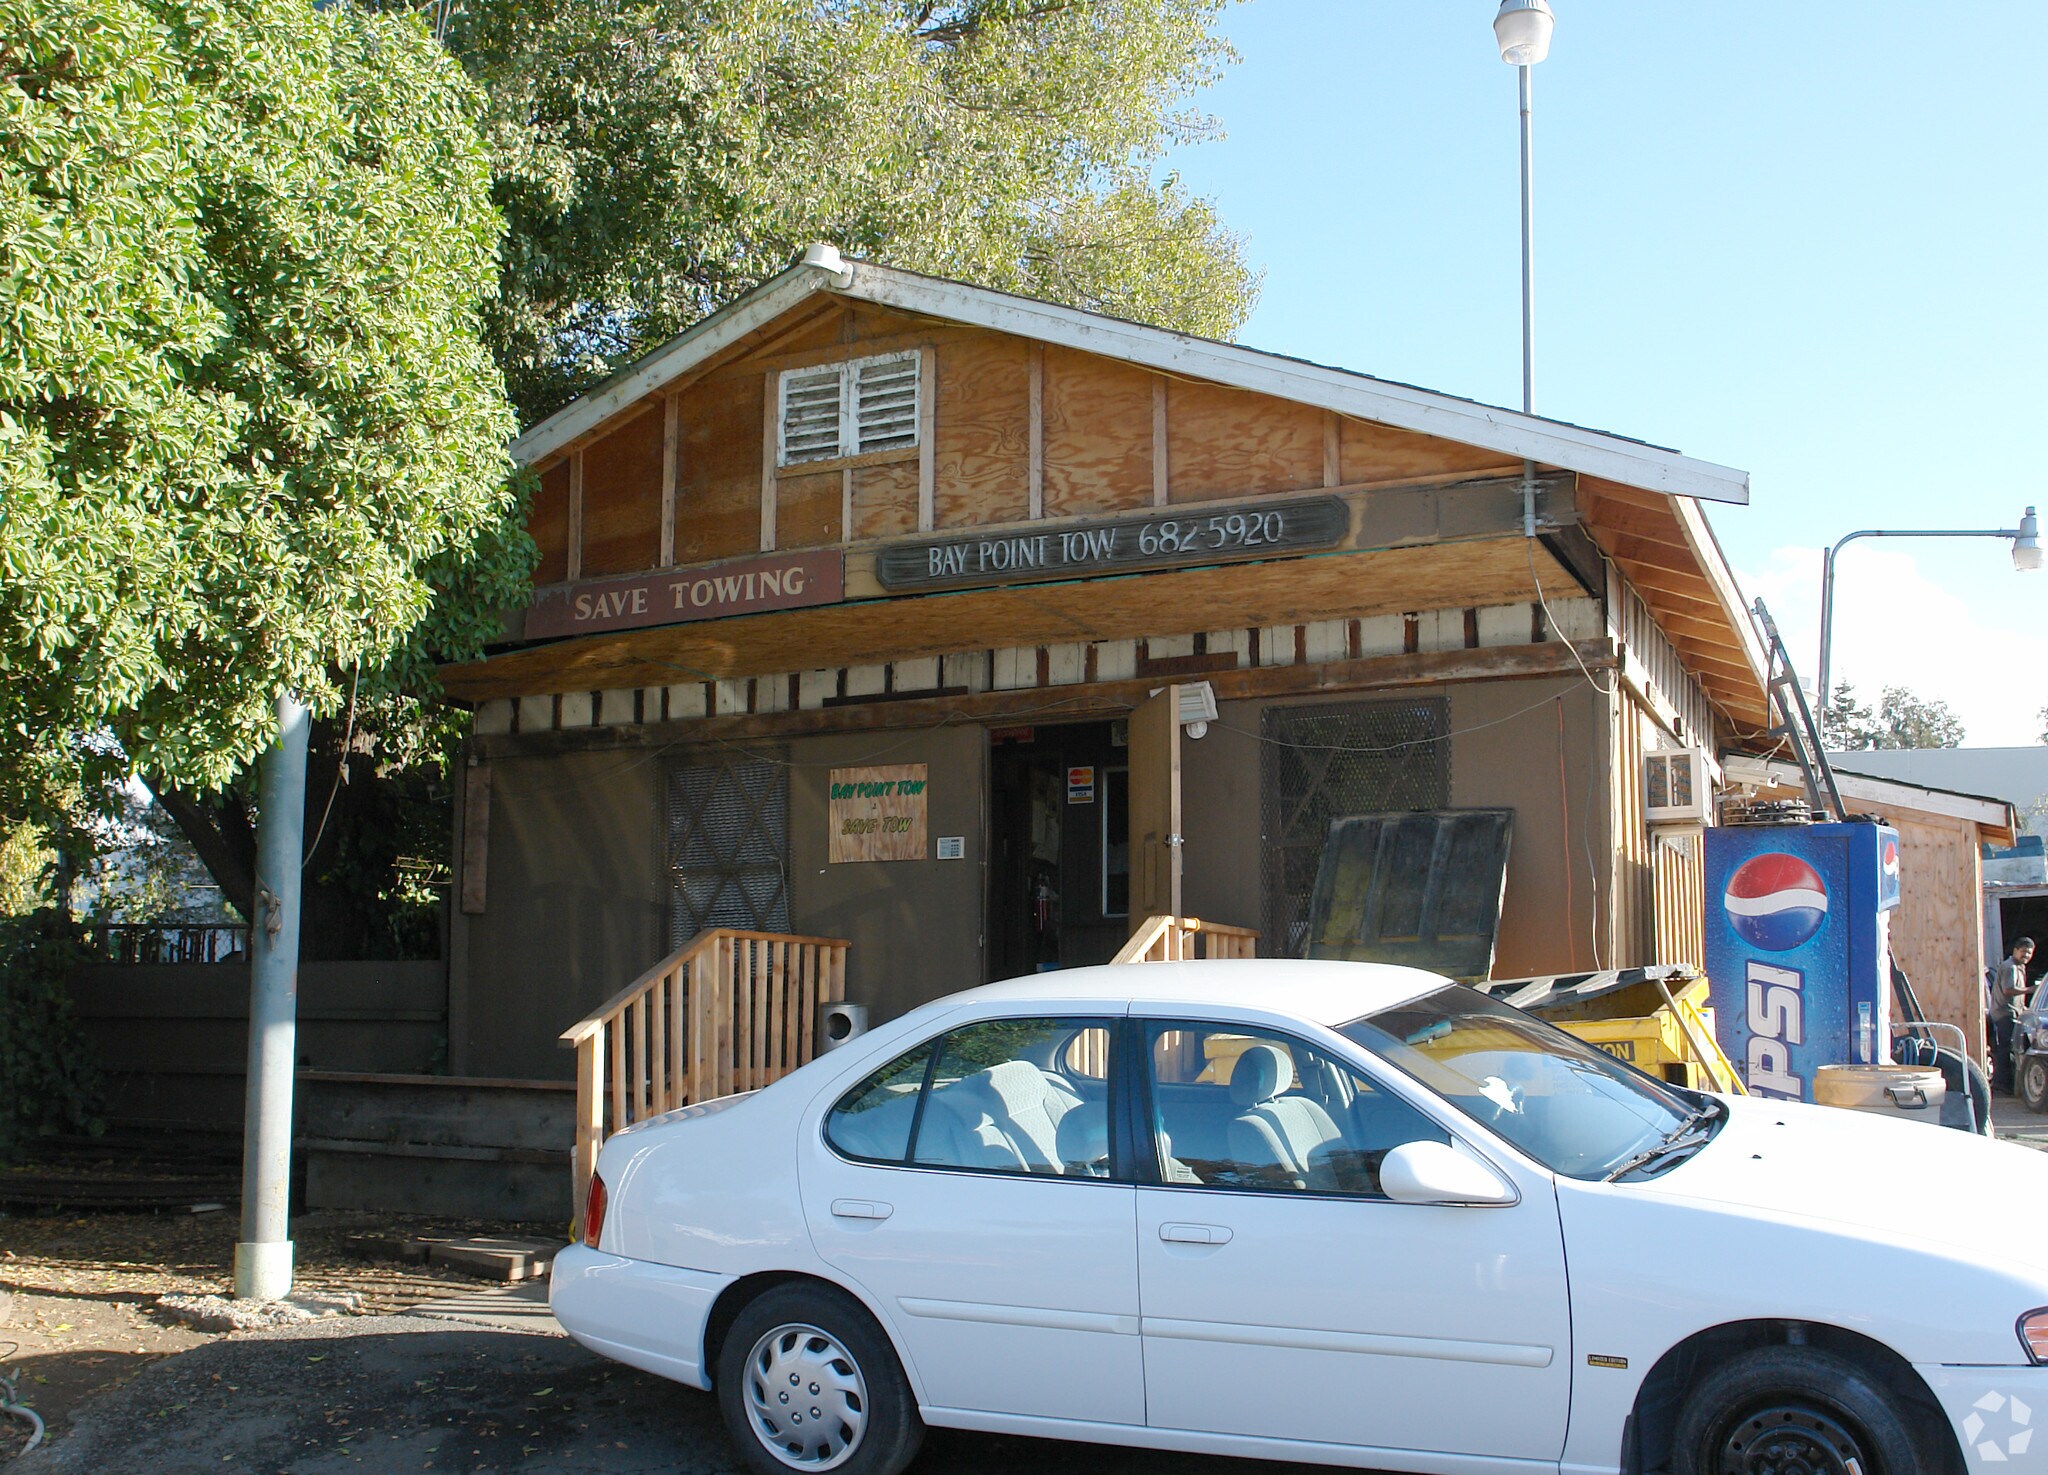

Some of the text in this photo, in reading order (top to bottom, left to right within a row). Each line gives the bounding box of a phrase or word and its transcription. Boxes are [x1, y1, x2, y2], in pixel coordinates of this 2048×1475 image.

[928, 544, 969, 577] BAY
[979, 535, 1048, 572] POINT
[1138, 511, 1284, 555] 682-5920
[574, 567, 805, 621] SAVE TOWING
[831, 780, 927, 800] BAY POINT TOW
[841, 816, 913, 835] SAVE TOW
[1747, 961, 1802, 1102] PSI
